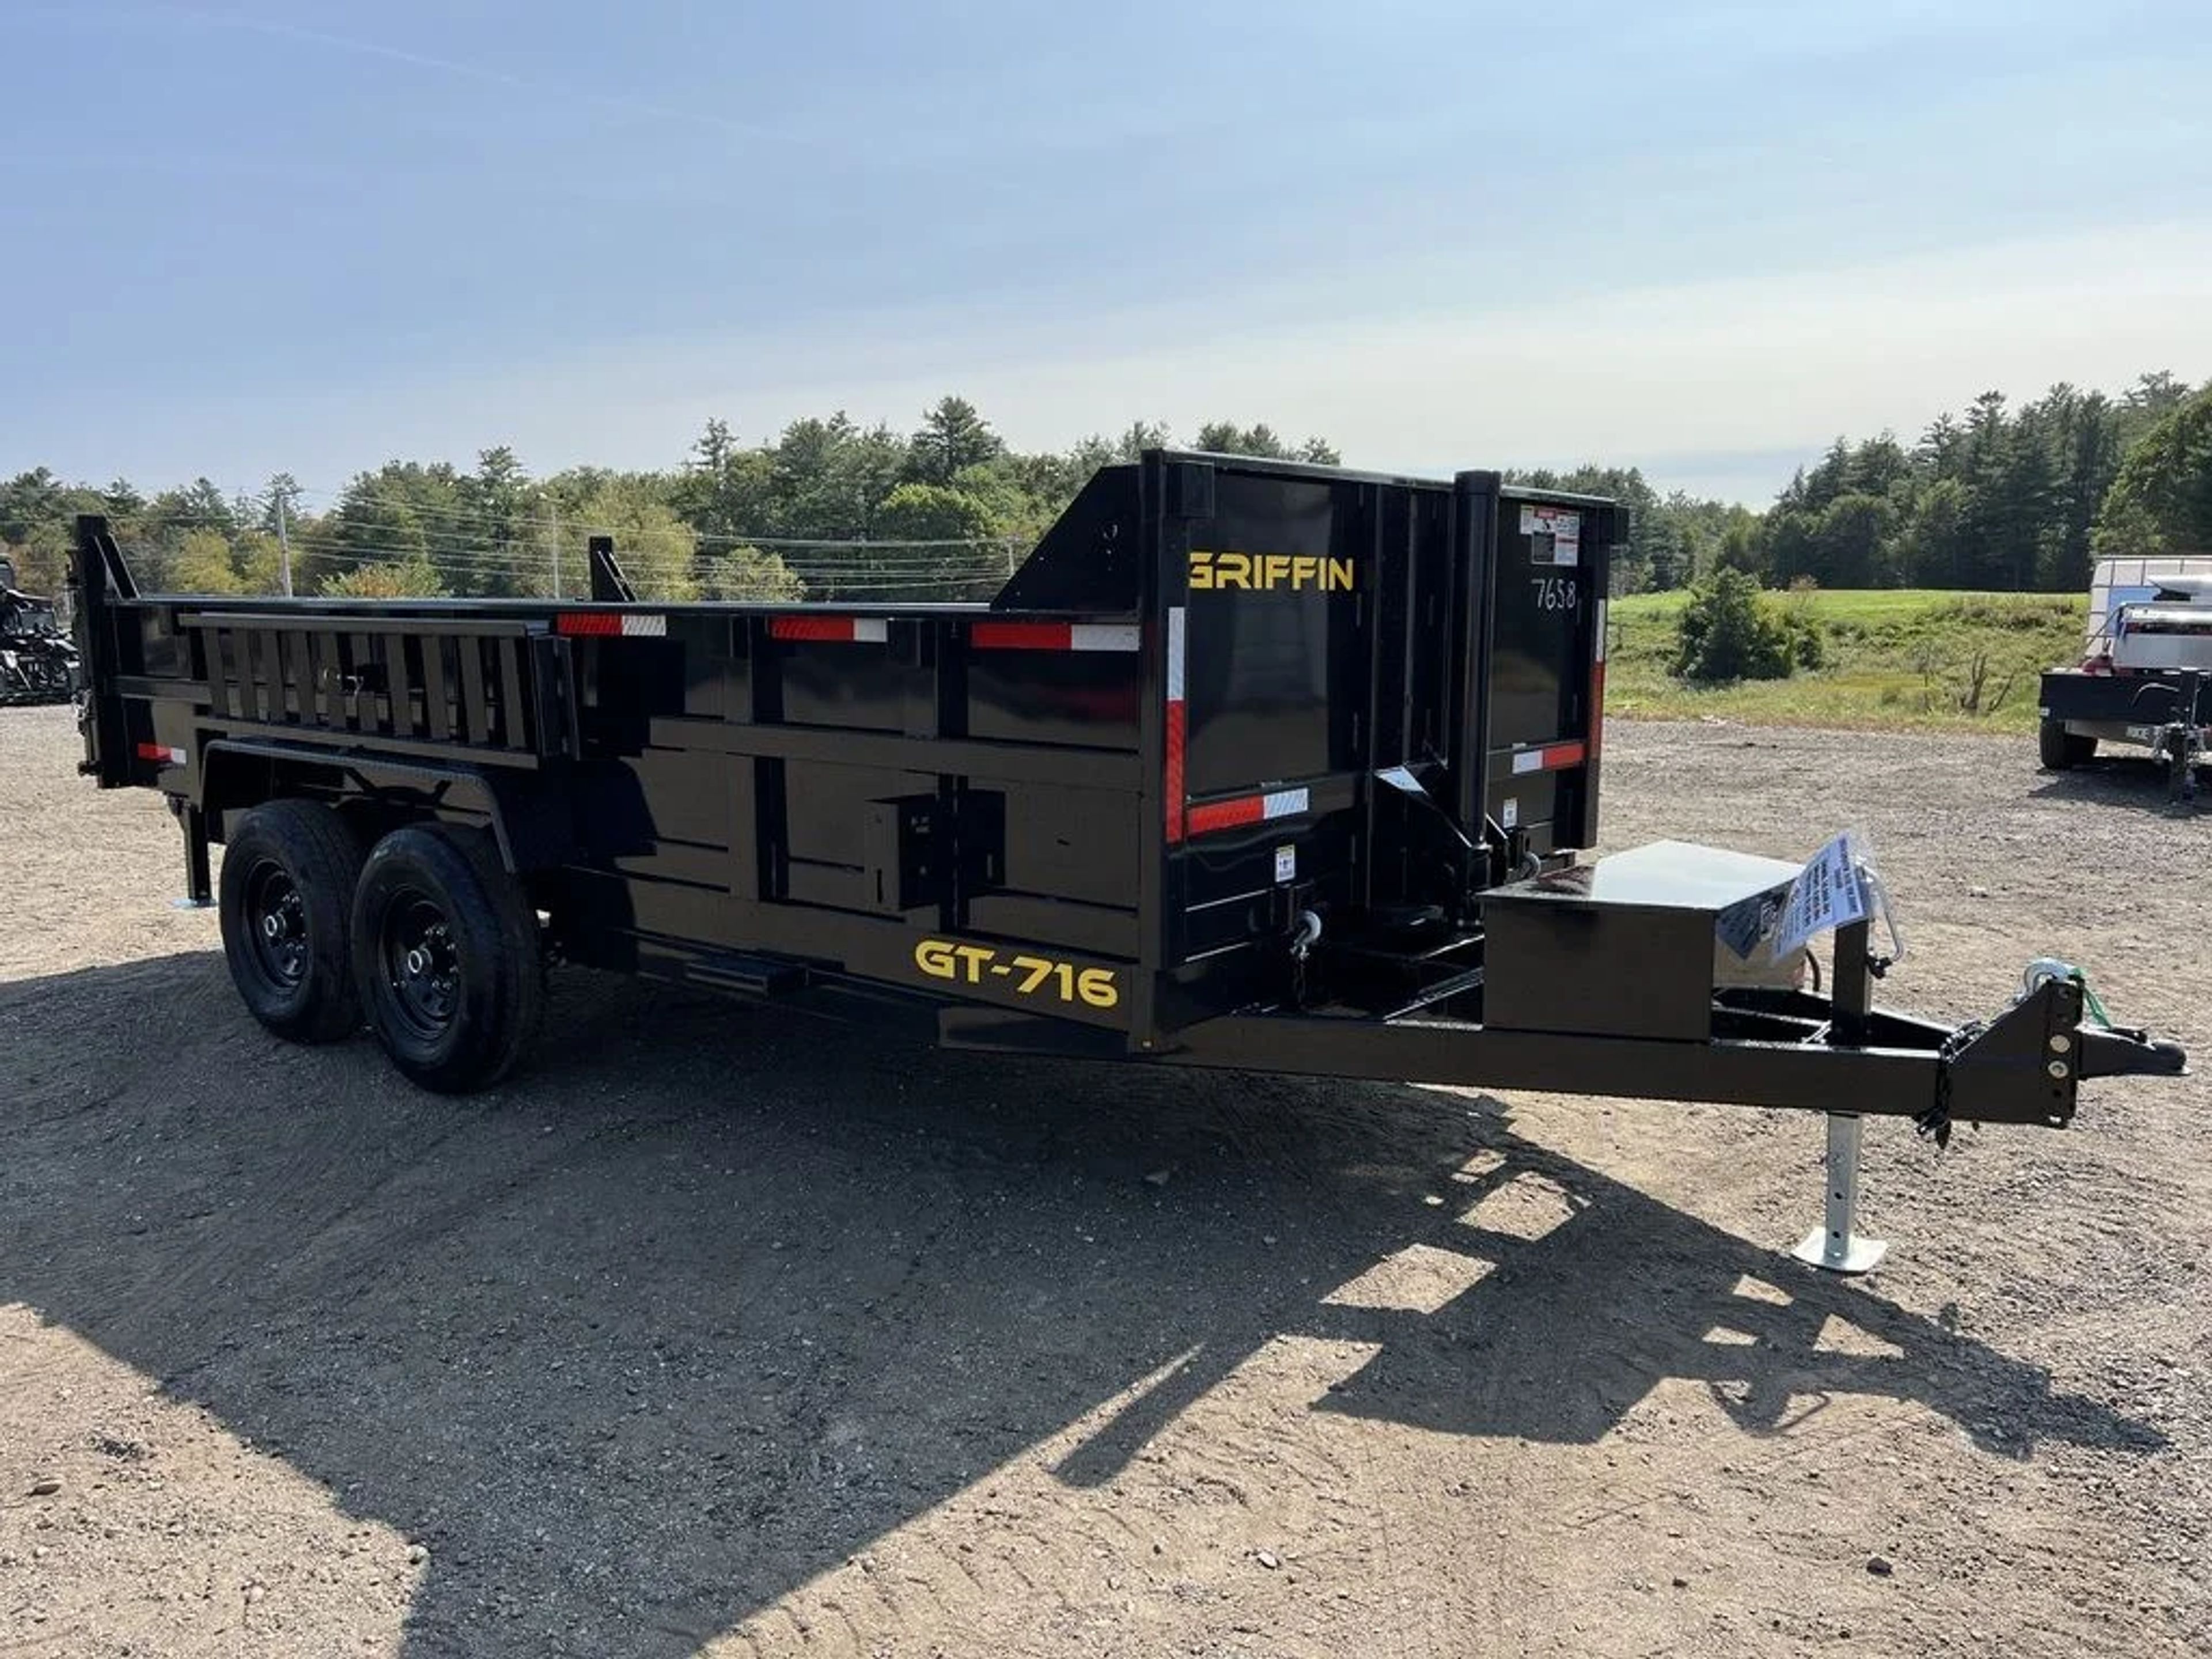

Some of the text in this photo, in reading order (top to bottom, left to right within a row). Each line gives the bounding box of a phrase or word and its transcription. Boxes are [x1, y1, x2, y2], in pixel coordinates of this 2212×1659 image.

[1189, 551, 1354, 590] GRIFFIN
[1531, 577, 1576, 610] 7658
[915, 940, 1119, 1008] GT-716
